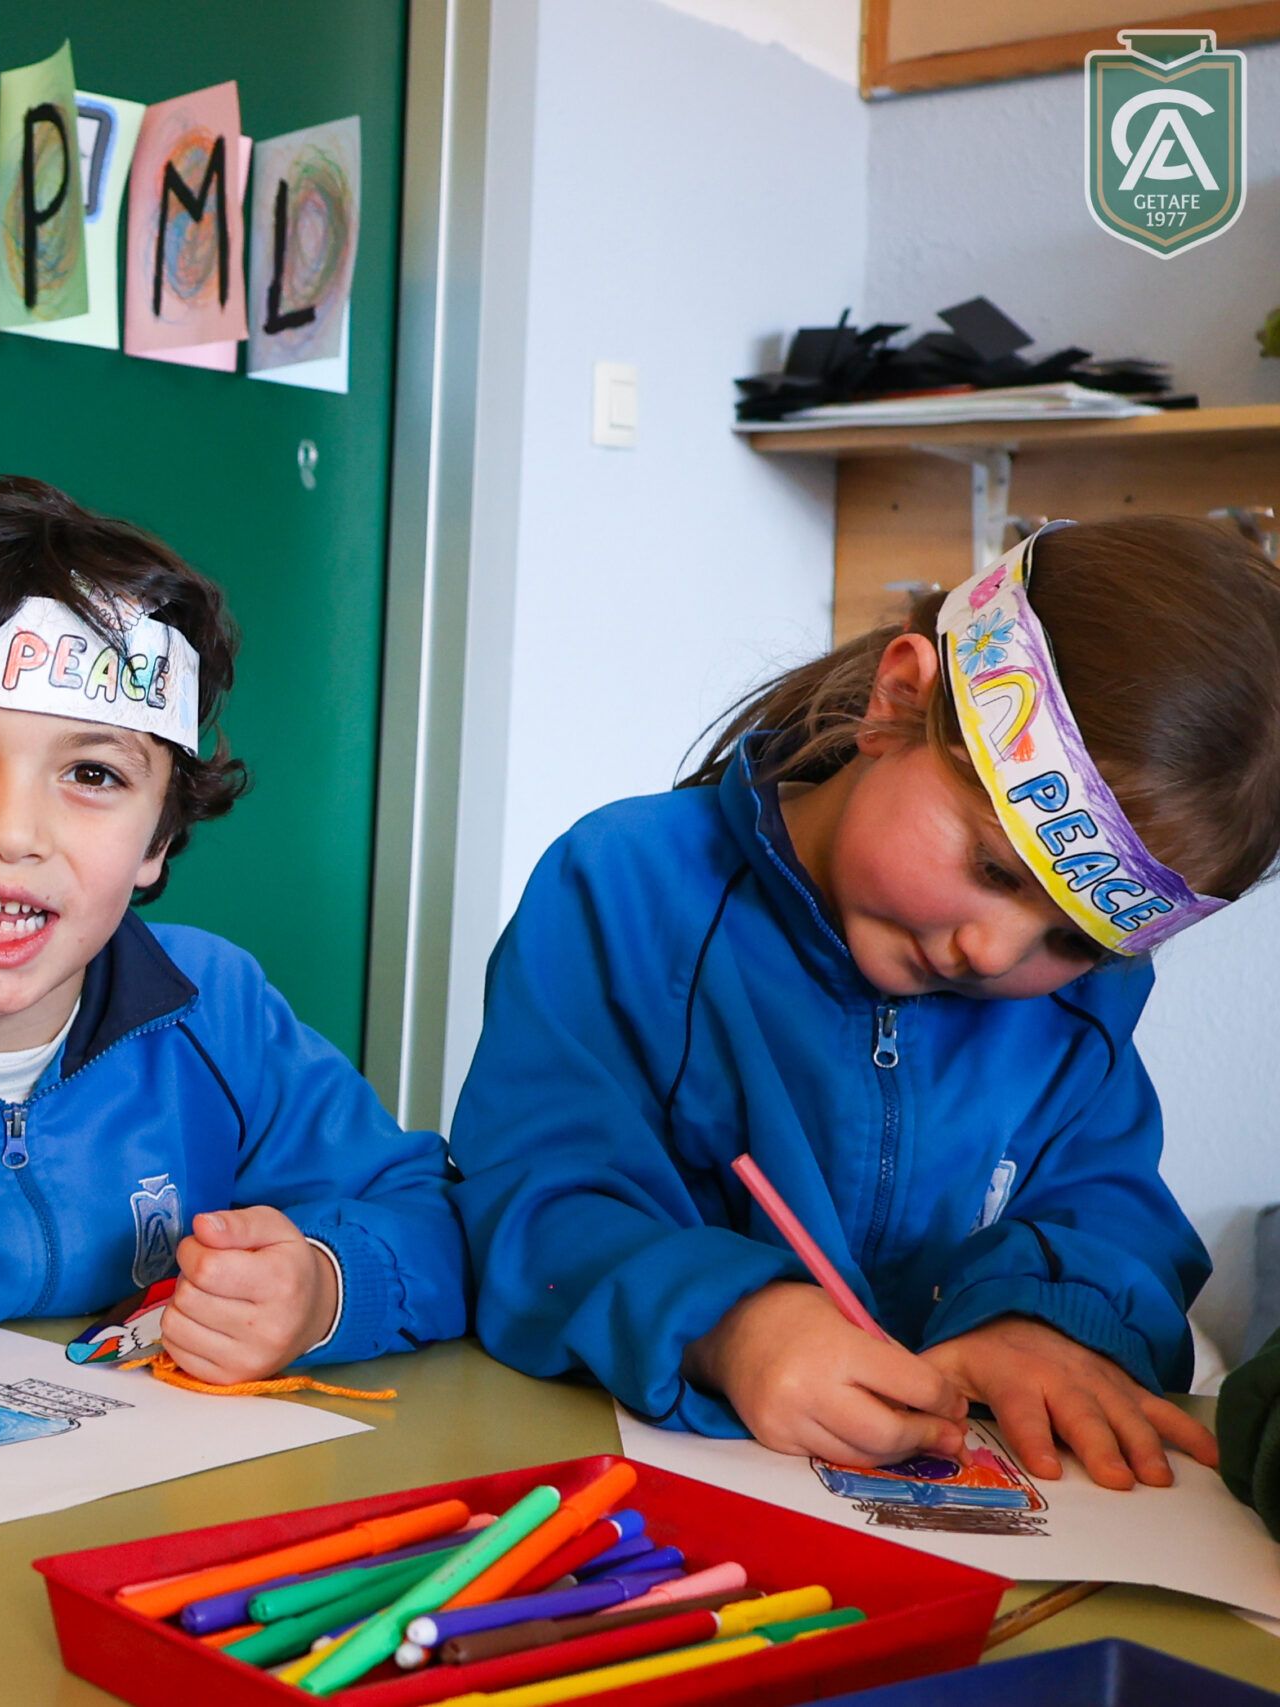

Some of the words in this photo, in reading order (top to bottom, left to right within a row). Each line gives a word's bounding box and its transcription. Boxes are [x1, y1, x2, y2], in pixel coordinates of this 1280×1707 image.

[23, 102, 71, 311] P
[151, 133, 230, 318] M
[263, 178, 318, 336] L
[1, 629, 170, 710] PEACE
[1006, 769, 1174, 932] PEACE
